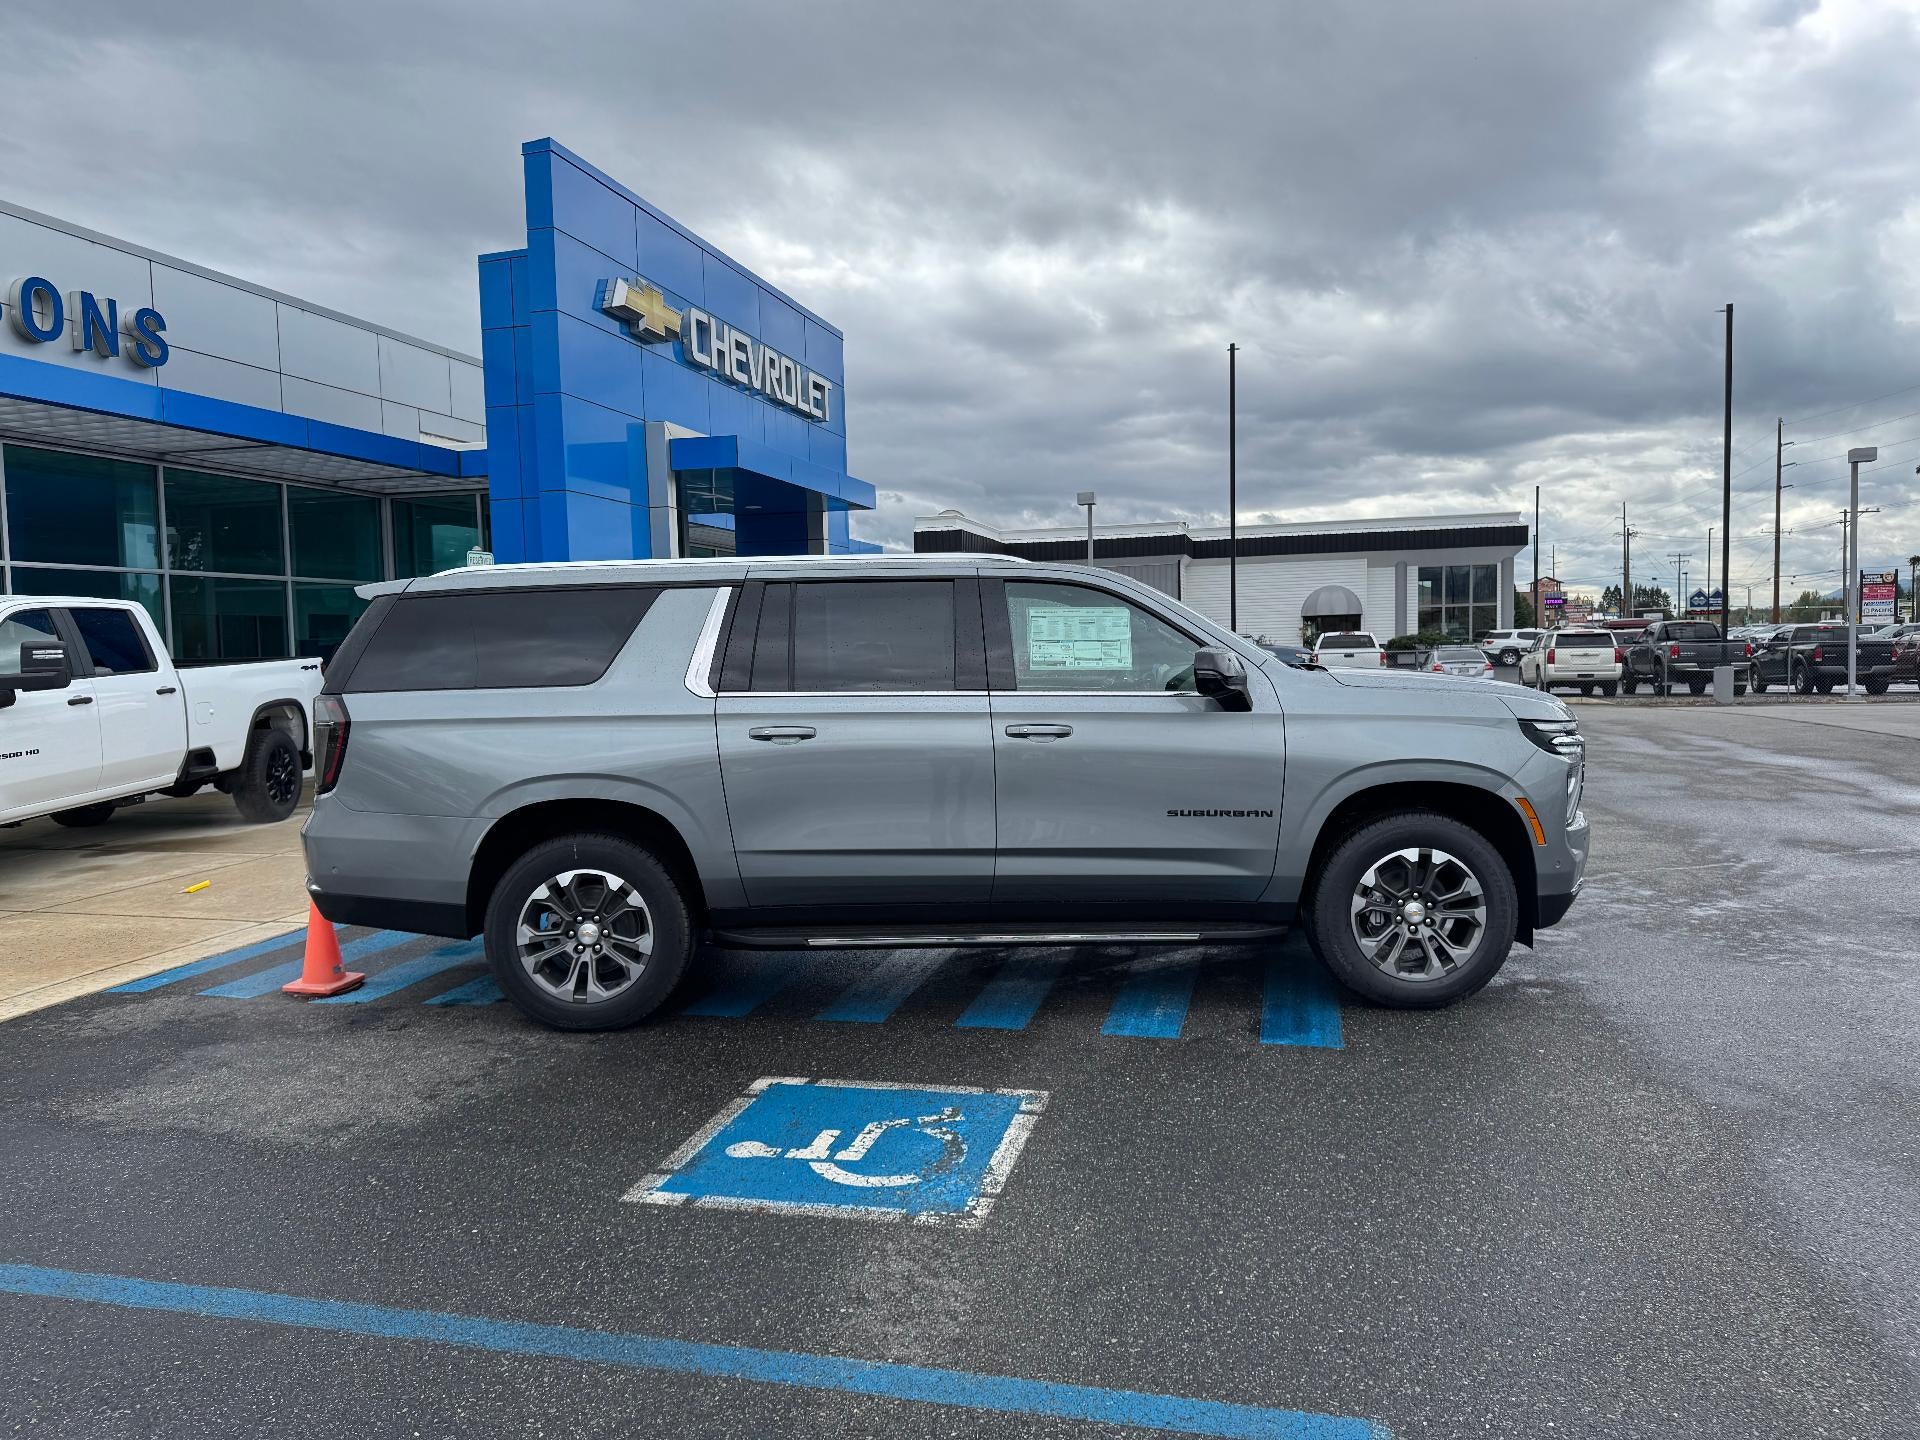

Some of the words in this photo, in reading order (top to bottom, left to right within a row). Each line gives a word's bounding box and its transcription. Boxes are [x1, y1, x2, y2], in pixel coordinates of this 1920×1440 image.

[0, 276, 169, 368] ONS
[685, 307, 833, 422] CHEVROLET
[0, 751, 23, 760] 500
[25, 748, 40, 756] HD
